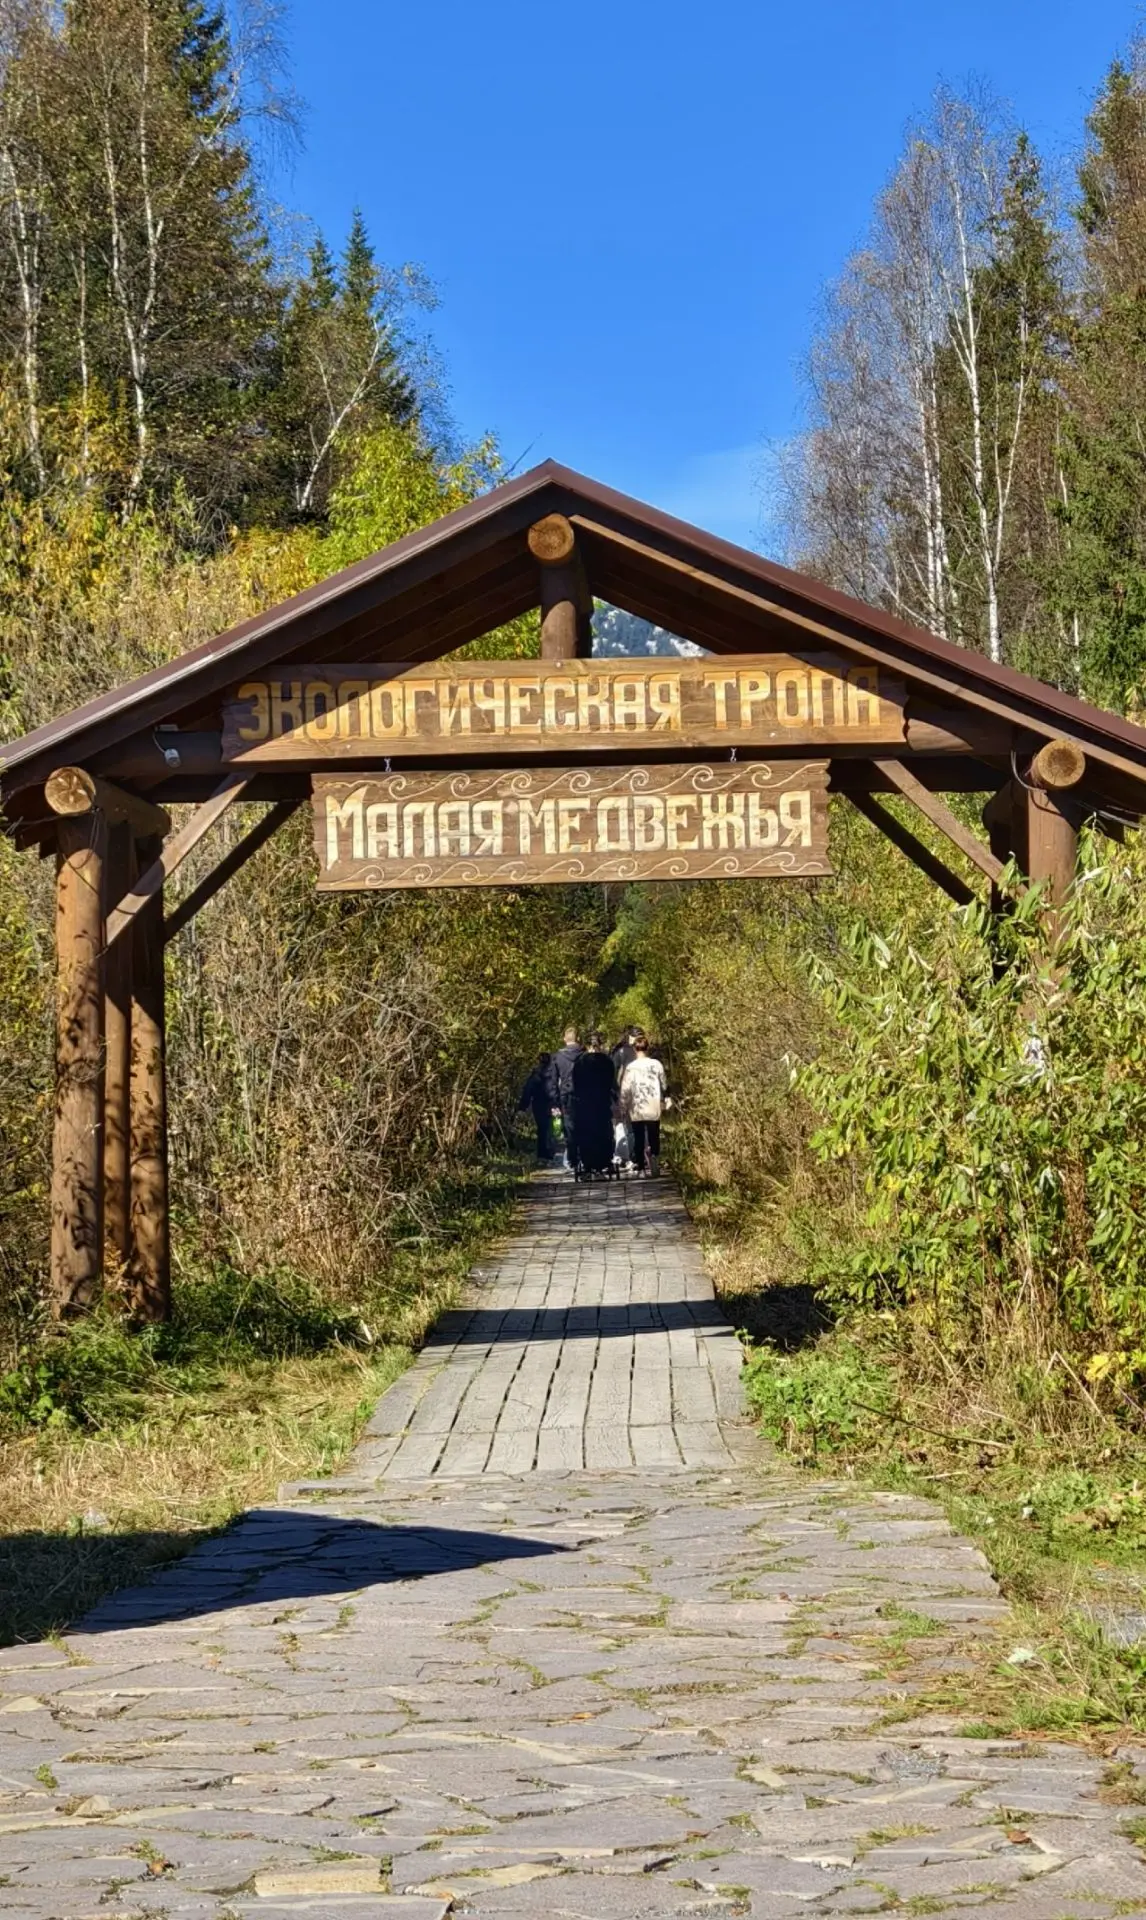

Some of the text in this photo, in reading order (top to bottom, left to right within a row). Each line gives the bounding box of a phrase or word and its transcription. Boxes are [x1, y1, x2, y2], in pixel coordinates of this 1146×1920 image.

[238, 666, 881, 740] ЭКОЛОГИЧЕСКАЯ ТРОПА
[325, 786, 813, 870] МАЛАЯ МЕДВЕЖЬЯ
